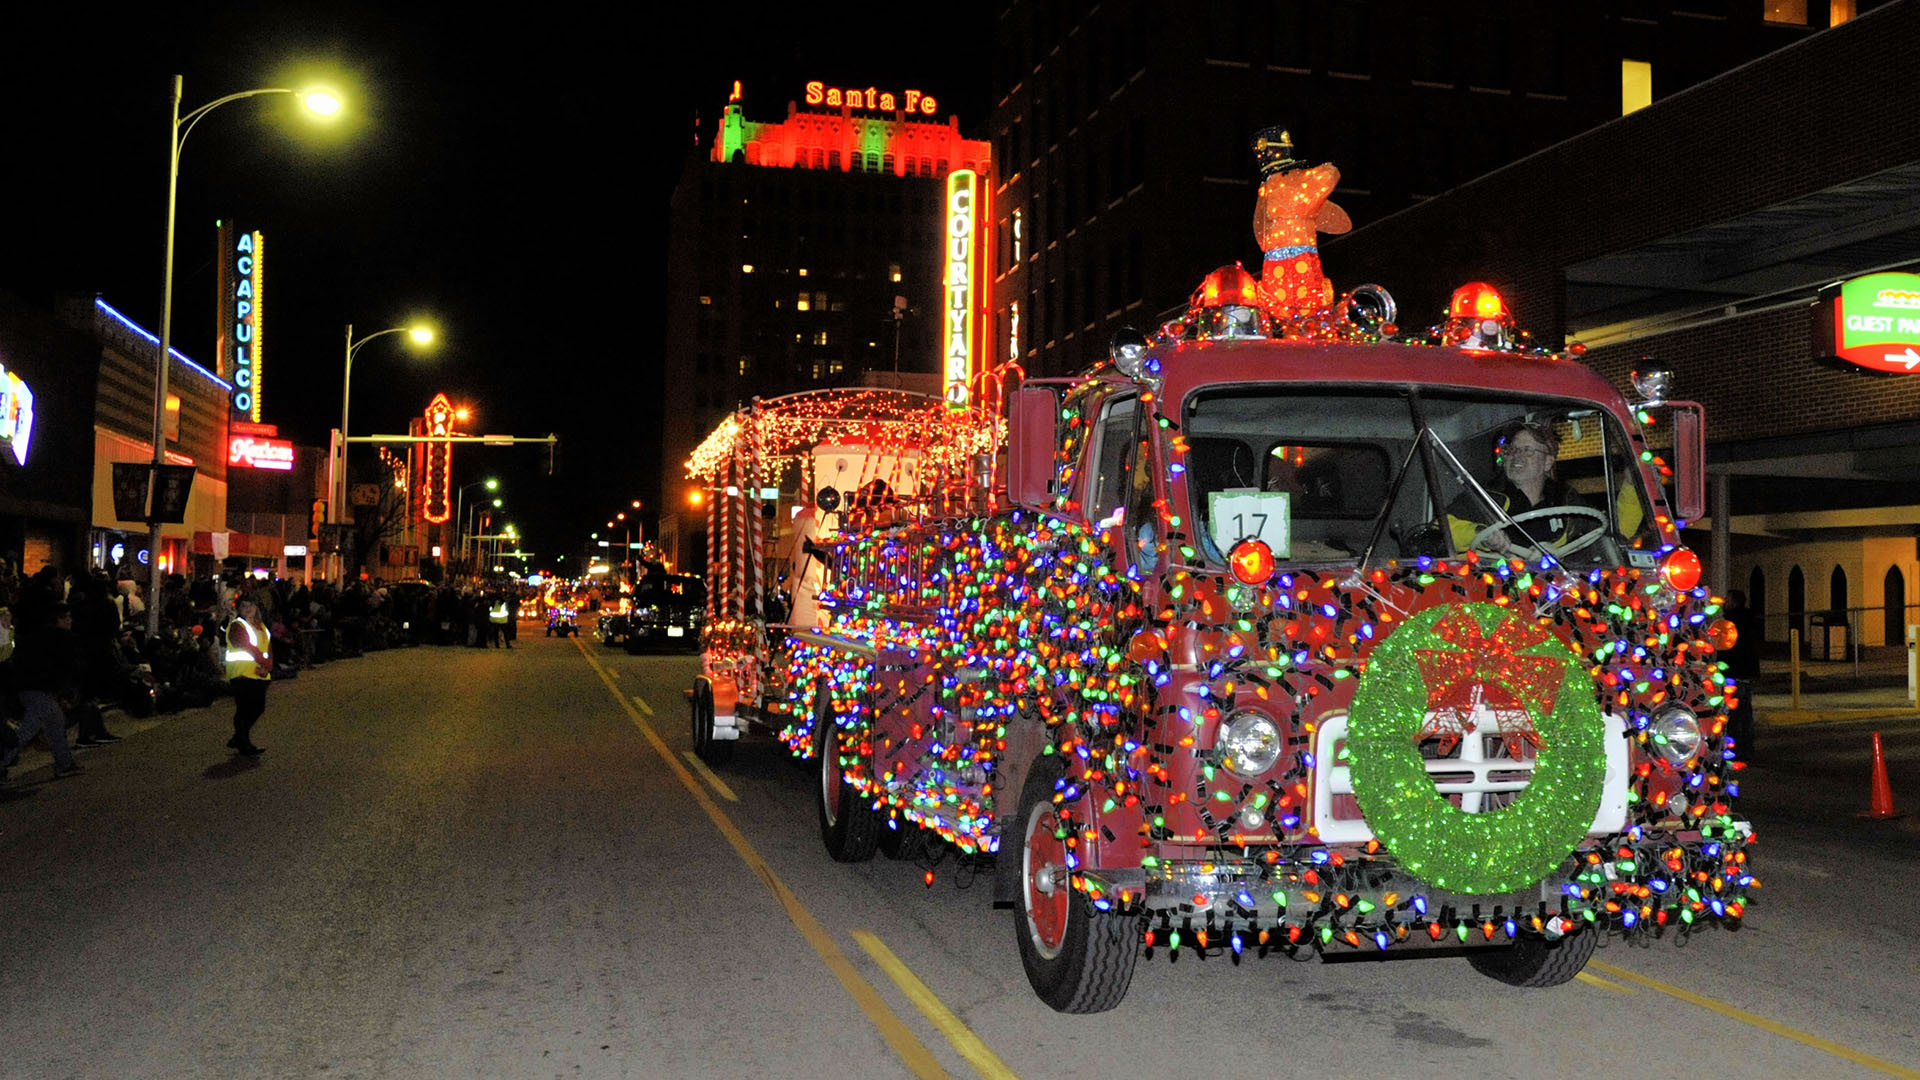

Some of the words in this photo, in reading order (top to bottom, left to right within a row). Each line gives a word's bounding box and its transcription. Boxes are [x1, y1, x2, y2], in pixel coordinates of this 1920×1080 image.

[806, 81, 895, 111] Santa
[904, 90, 937, 115] Fe
[948, 189, 969, 404] COURTYARD
[234, 233, 252, 411] ACAPULCO
[1847, 315, 1893, 332] GUEST
[1232, 513, 1268, 541] 17
